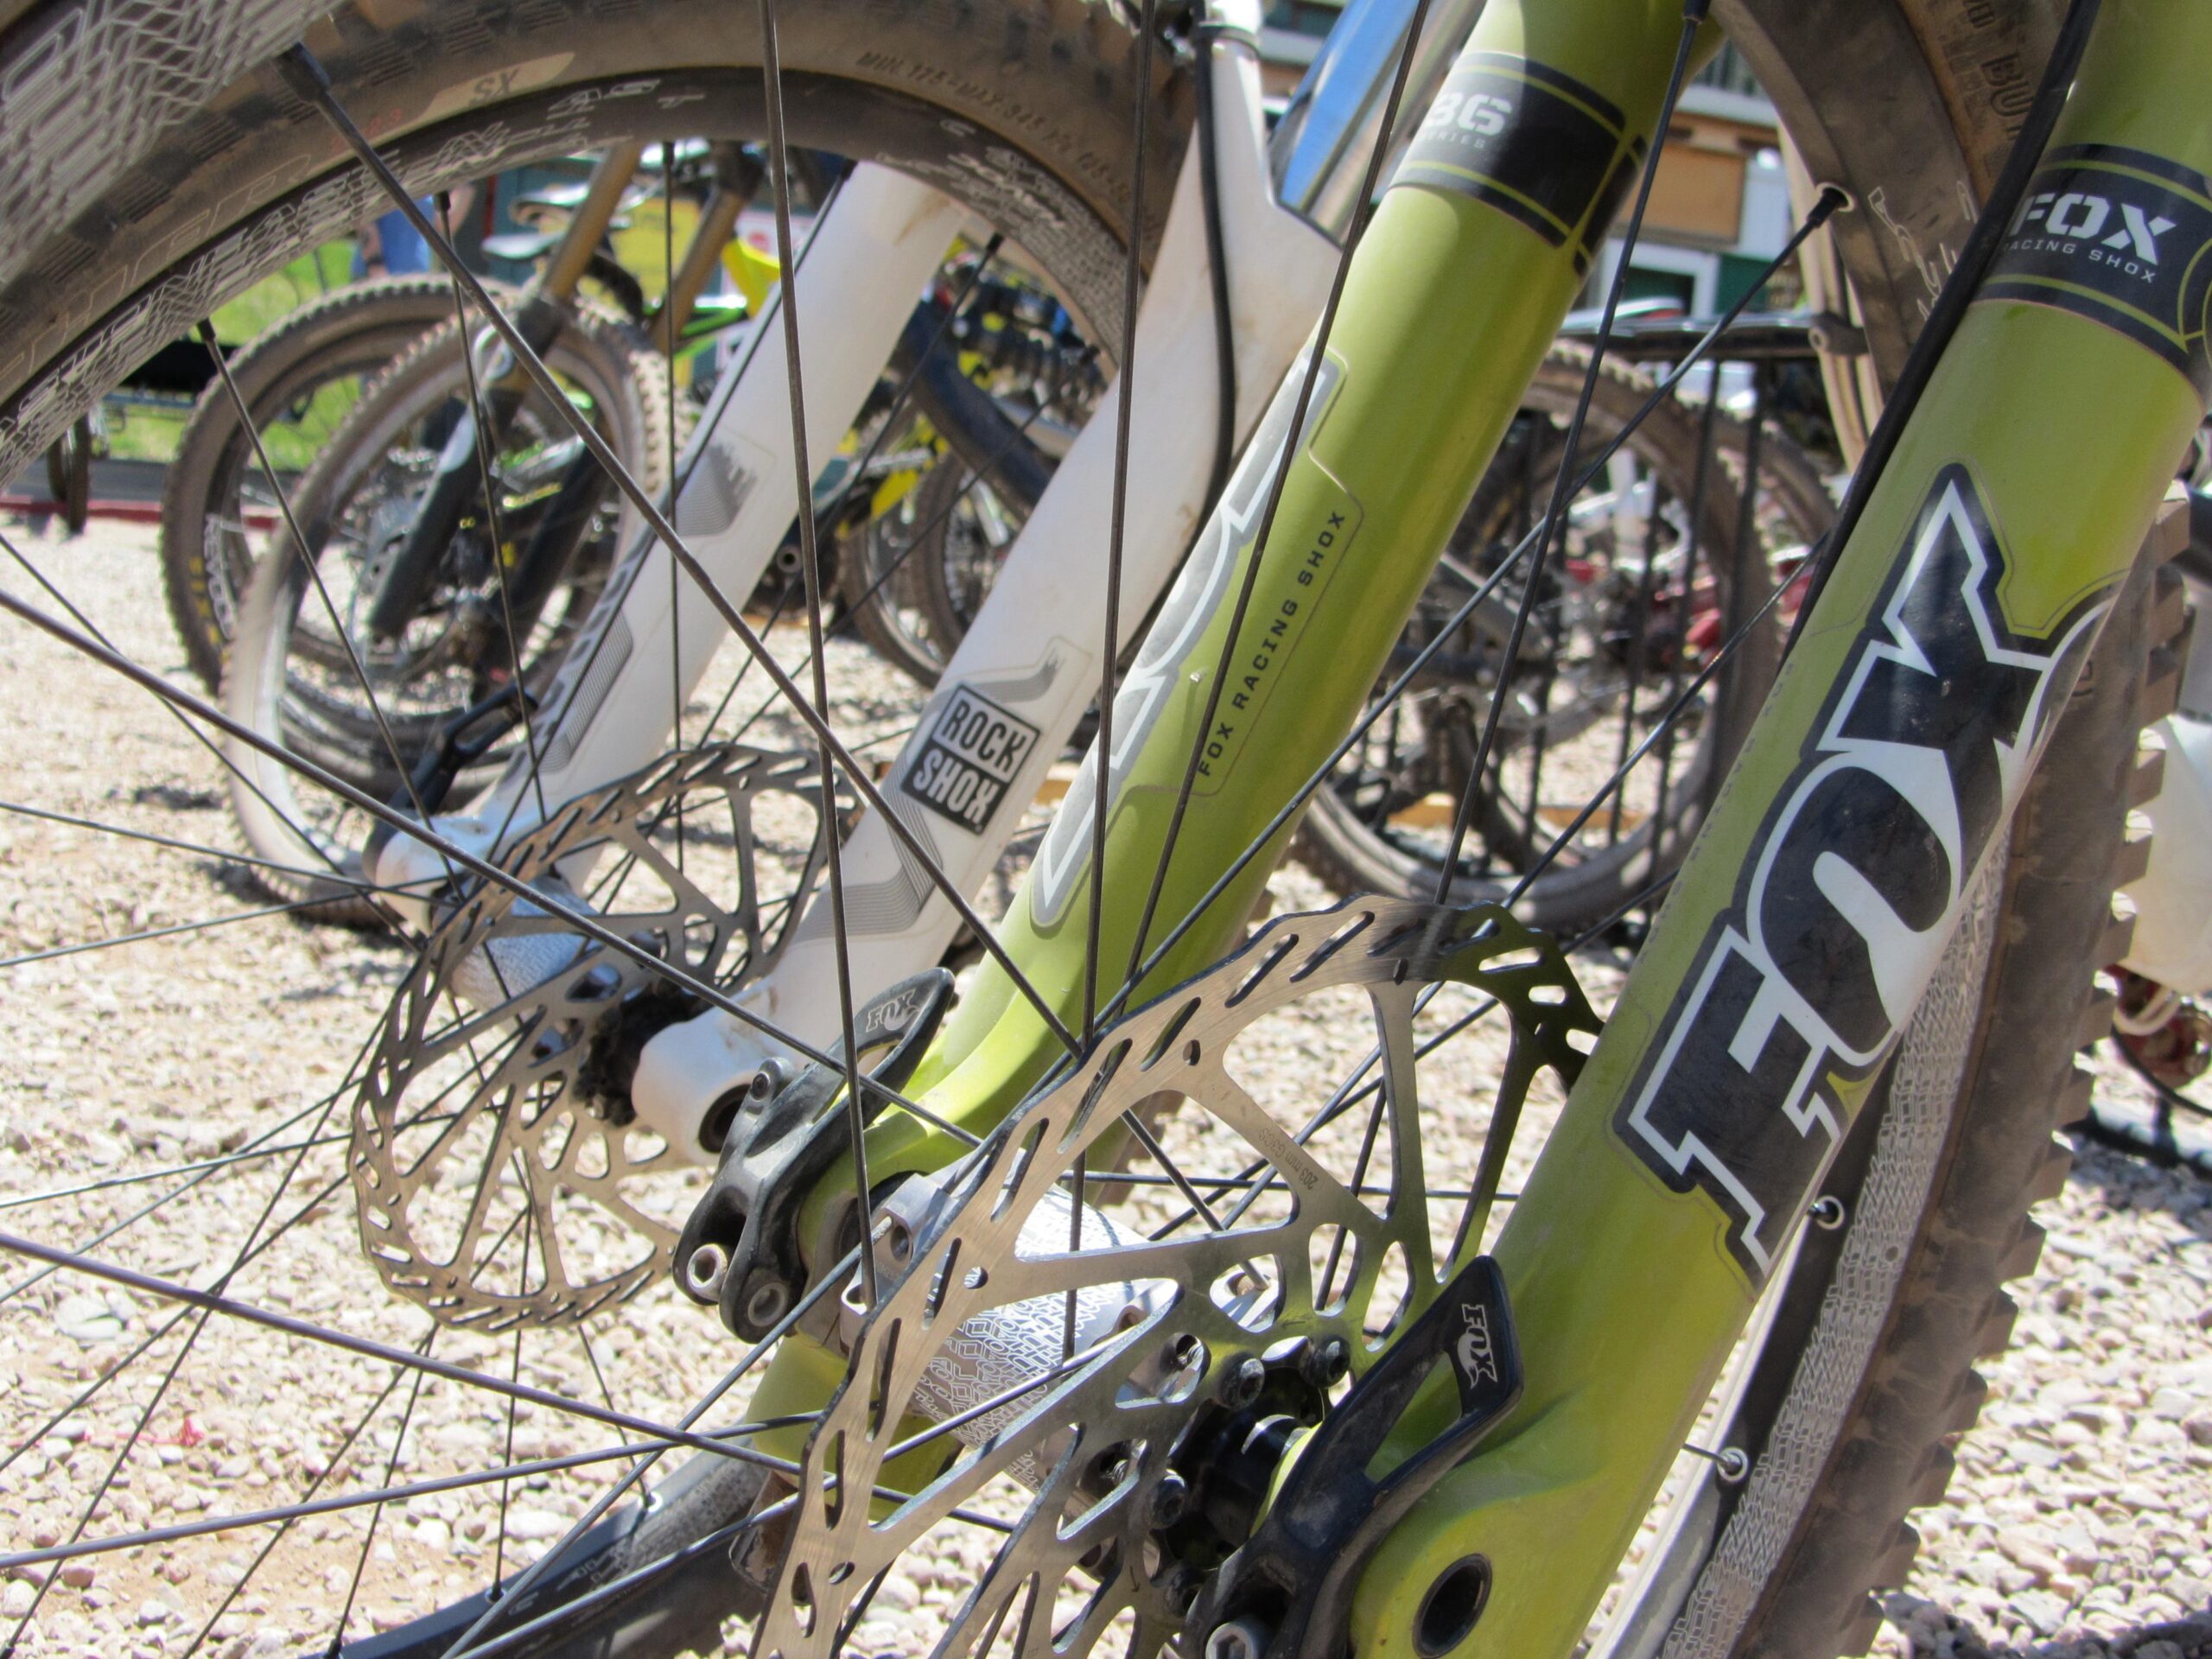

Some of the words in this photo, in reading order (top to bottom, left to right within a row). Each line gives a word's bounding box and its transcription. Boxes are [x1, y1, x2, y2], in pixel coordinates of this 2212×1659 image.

[2009, 192, 2177, 266] FOX
[2088, 250, 2157, 283] SHOX
[1198, 722, 1234, 777] FOX
[1232, 599, 1299, 710] RACING
[1297, 511, 1345, 587] SHOX
[943, 699, 1027, 772] ROCK
[912, 747, 1001, 824] SHOX
[1611, 464, 2130, 1283] FOX
[866, 988, 919, 1033] FOX
[1300, 1167, 1319, 1190] 203
[1457, 1303, 1498, 1389] FOX
